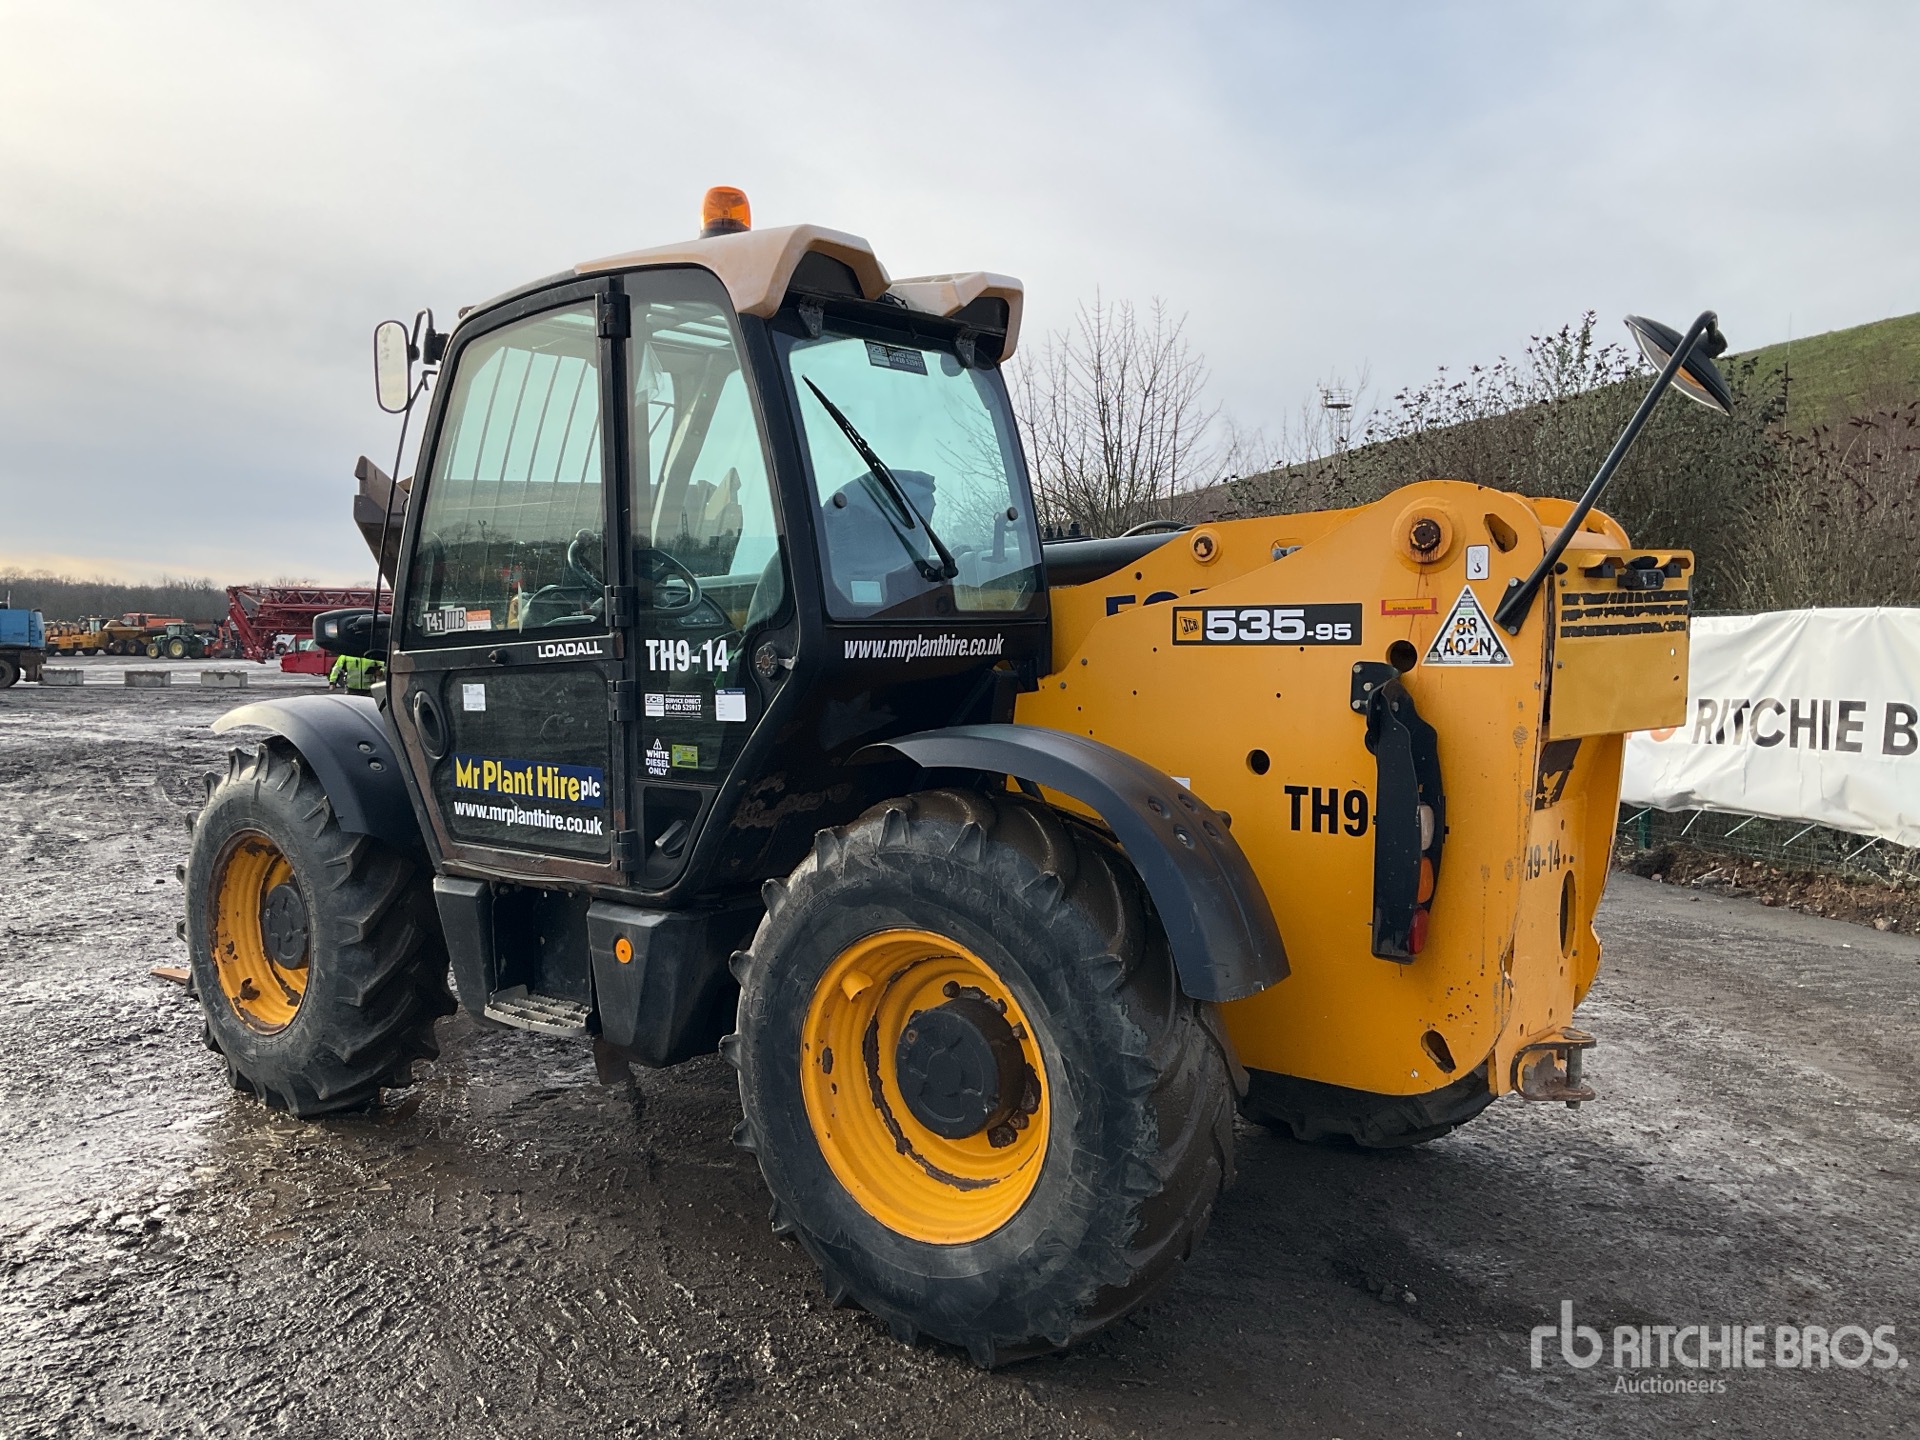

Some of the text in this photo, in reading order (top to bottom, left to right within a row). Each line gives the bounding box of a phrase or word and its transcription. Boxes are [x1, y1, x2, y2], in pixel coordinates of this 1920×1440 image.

[423, 612, 445, 632] T4i
[1181, 609, 1352, 641] JCB 535-95
[1456, 617, 1478, 636] 88
[537, 641, 603, 658] LOADALL
[645, 639, 729, 672] TH9-14
[844, 633, 1005, 663] www.mrplanthire.co.uk
[646, 695, 664, 704] JCB
[1692, 697, 1867, 753] RITCHIE
[645, 758, 670, 768] DIESEL
[646, 749, 670, 760] WHITE
[455, 757, 480, 791] Mr
[483, 759, 534, 797] Plant
[648, 767, 668, 776] ONLY
[454, 801, 603, 836] www.mrplanthire.co.uk
